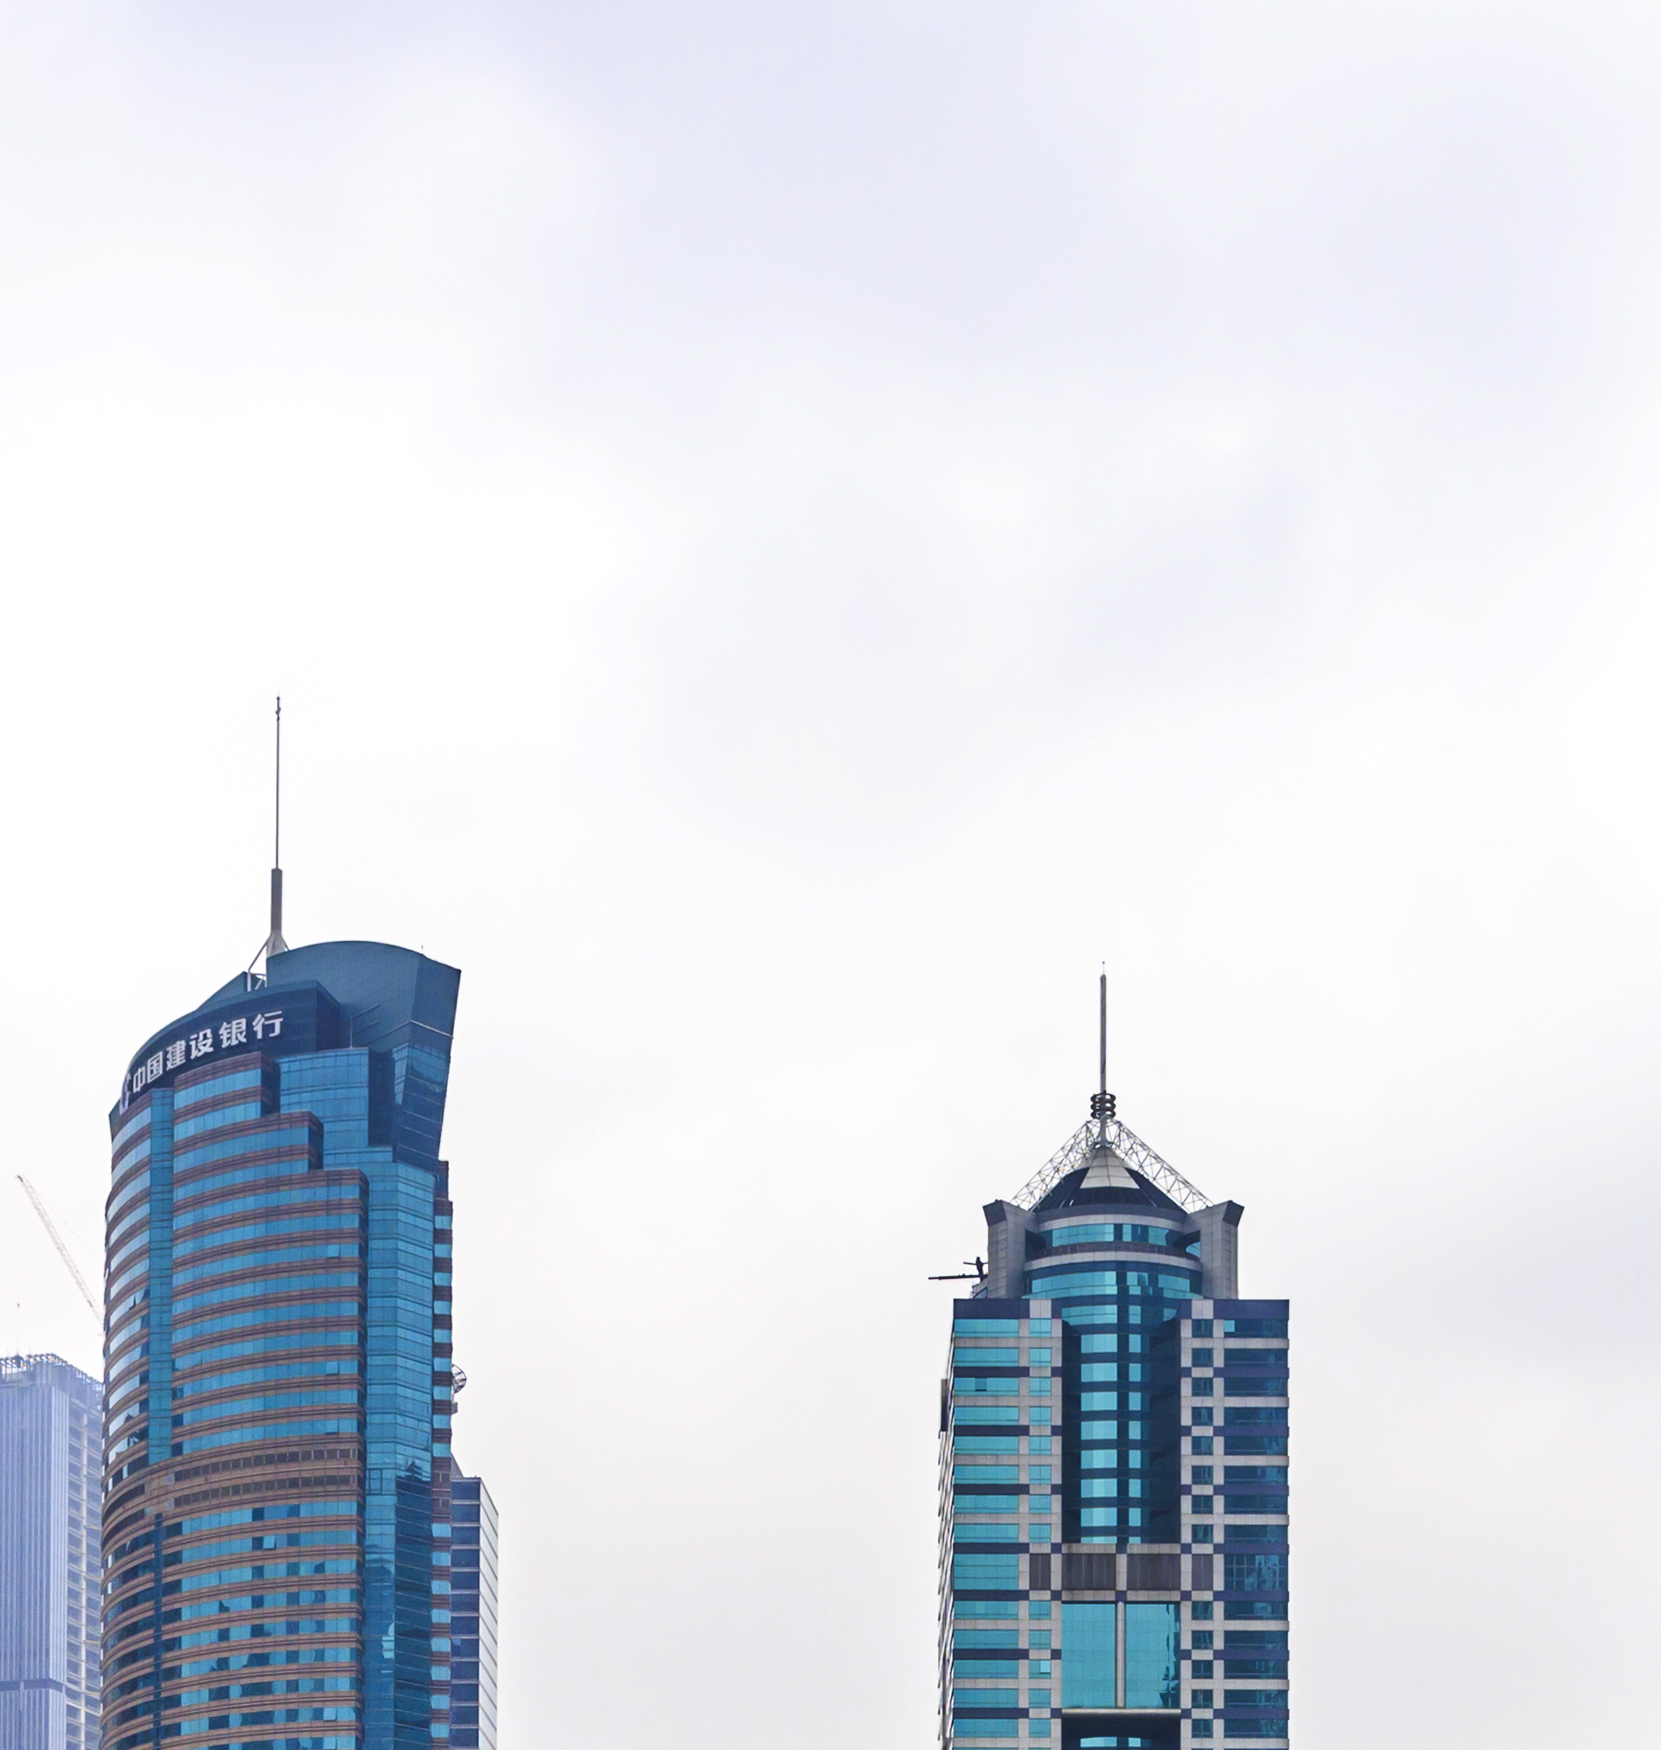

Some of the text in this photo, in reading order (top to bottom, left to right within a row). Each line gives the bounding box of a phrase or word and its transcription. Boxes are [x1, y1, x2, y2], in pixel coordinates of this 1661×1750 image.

[132, 1010, 284, 1094] 中国建设银行
